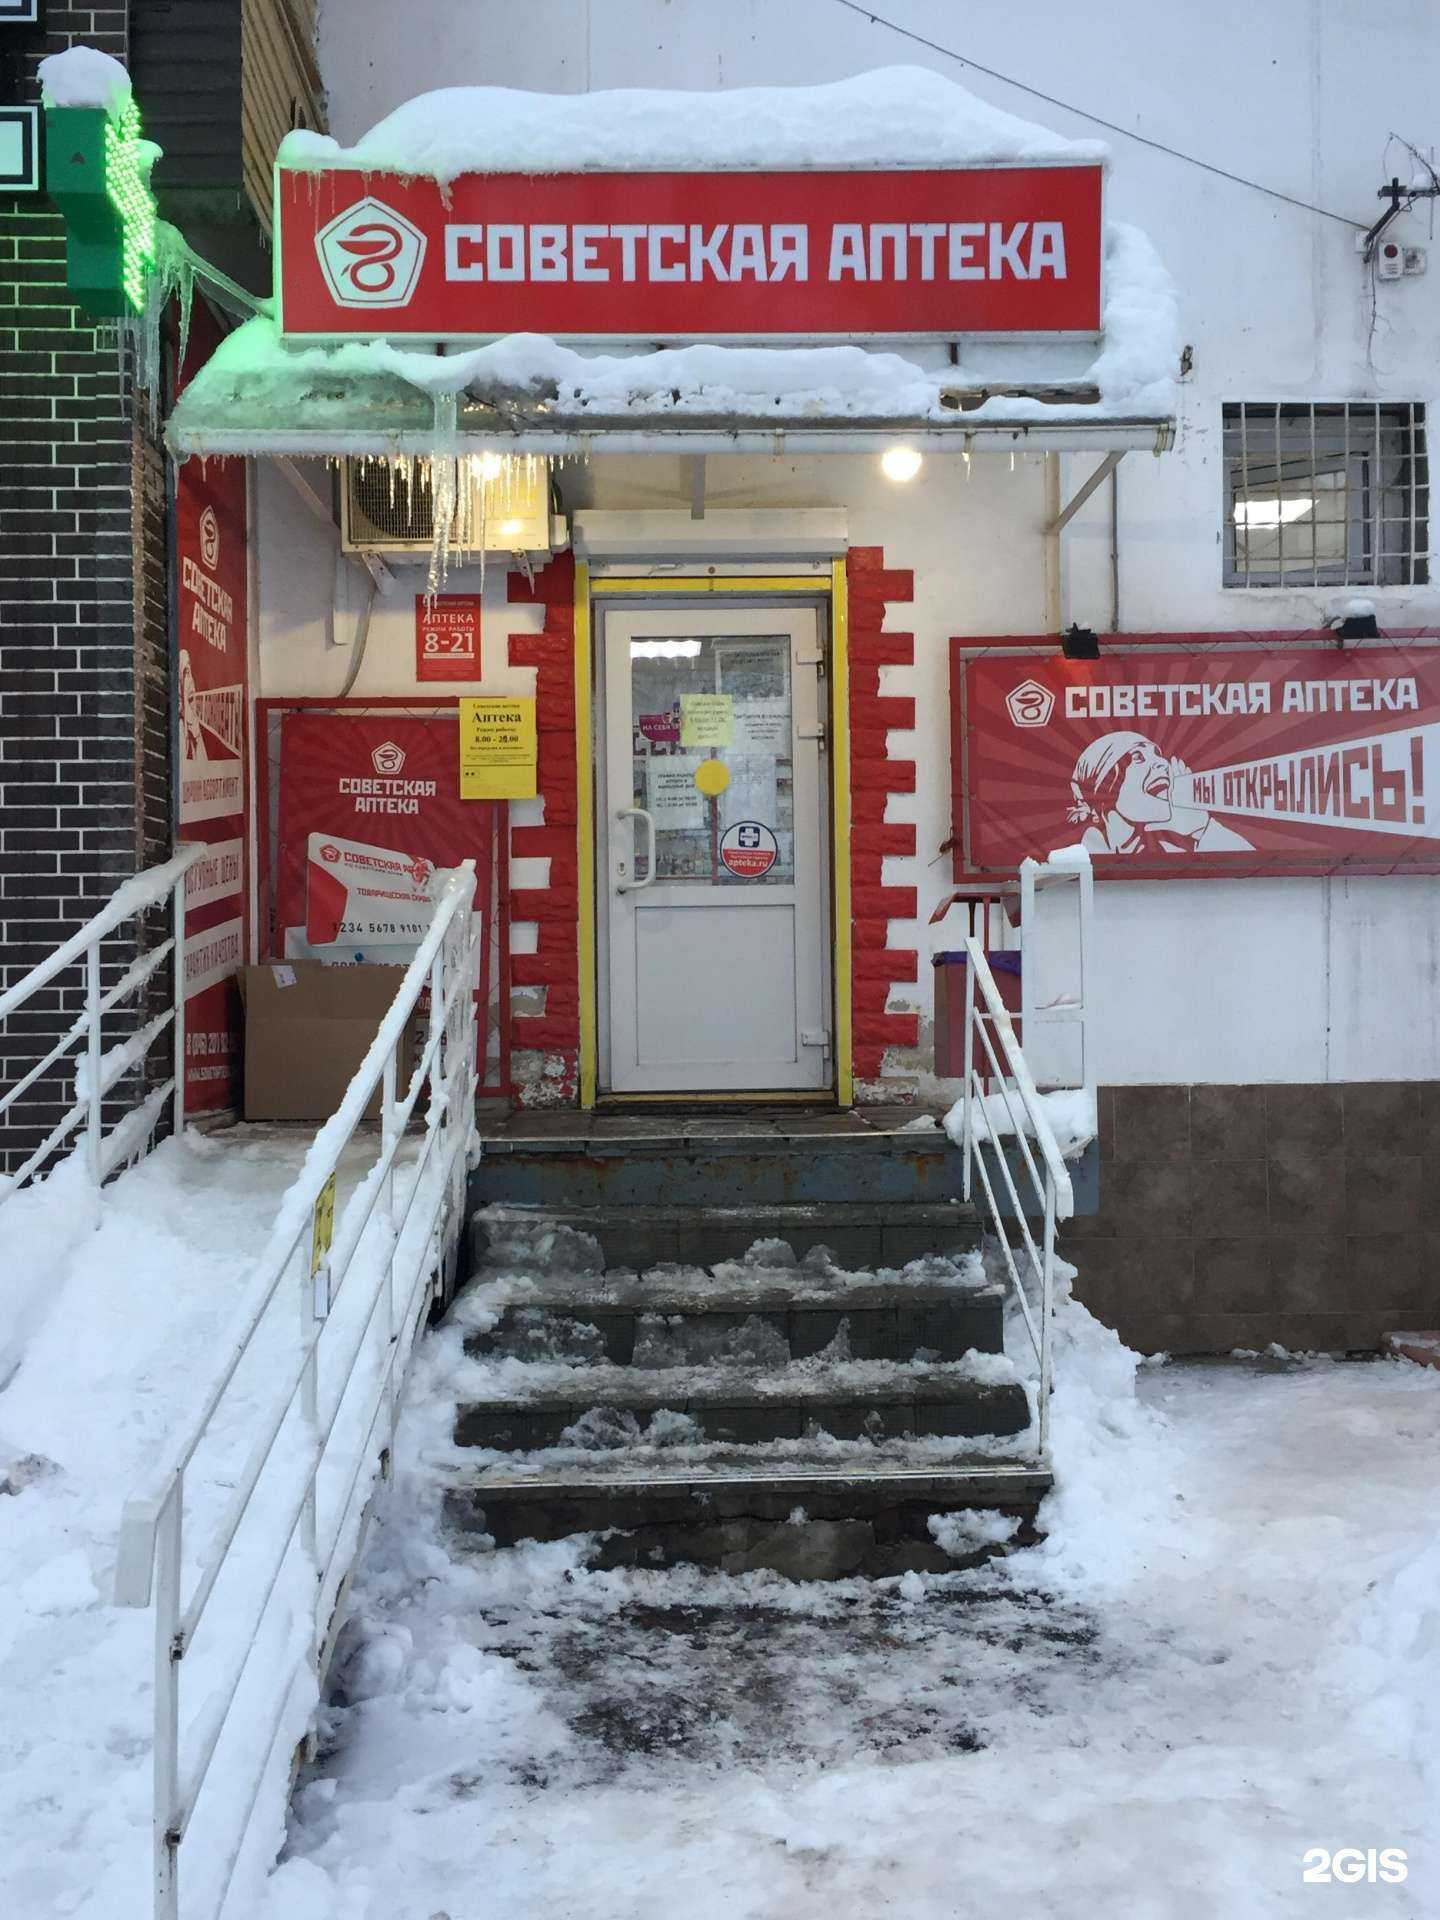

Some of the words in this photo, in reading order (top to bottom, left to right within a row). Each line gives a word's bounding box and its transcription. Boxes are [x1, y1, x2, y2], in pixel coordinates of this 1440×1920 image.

[444, 223, 808, 282] СОВЕТСКАЯ
[828, 221, 1068, 280] АПТЕКА
[183, 556, 233, 625] СОВЕТСКАЯ
[192, 600, 227, 654] АПТЕКА
[423, 612, 475, 625] АПТЕКА
[424, 632, 474, 653] 8-21
[1064, 682, 1271, 718] СОВЕТСКАЯ
[1282, 677, 1419, 714] АПТЕКА
[471, 711, 523, 723] Аптека
[339, 777, 437, 797] СОВЕТСКАЯ
[1192, 774, 1216, 805] МЫ
[1223, 735, 1426, 825] ОТКРЫЛИСЬ!
[354, 797, 420, 815] АПТЕКА
[344, 851, 401, 872] СОВЕТСКАЯ
[728, 859, 768, 867] apteka.ru
[369, 922, 397, 933] 5678
